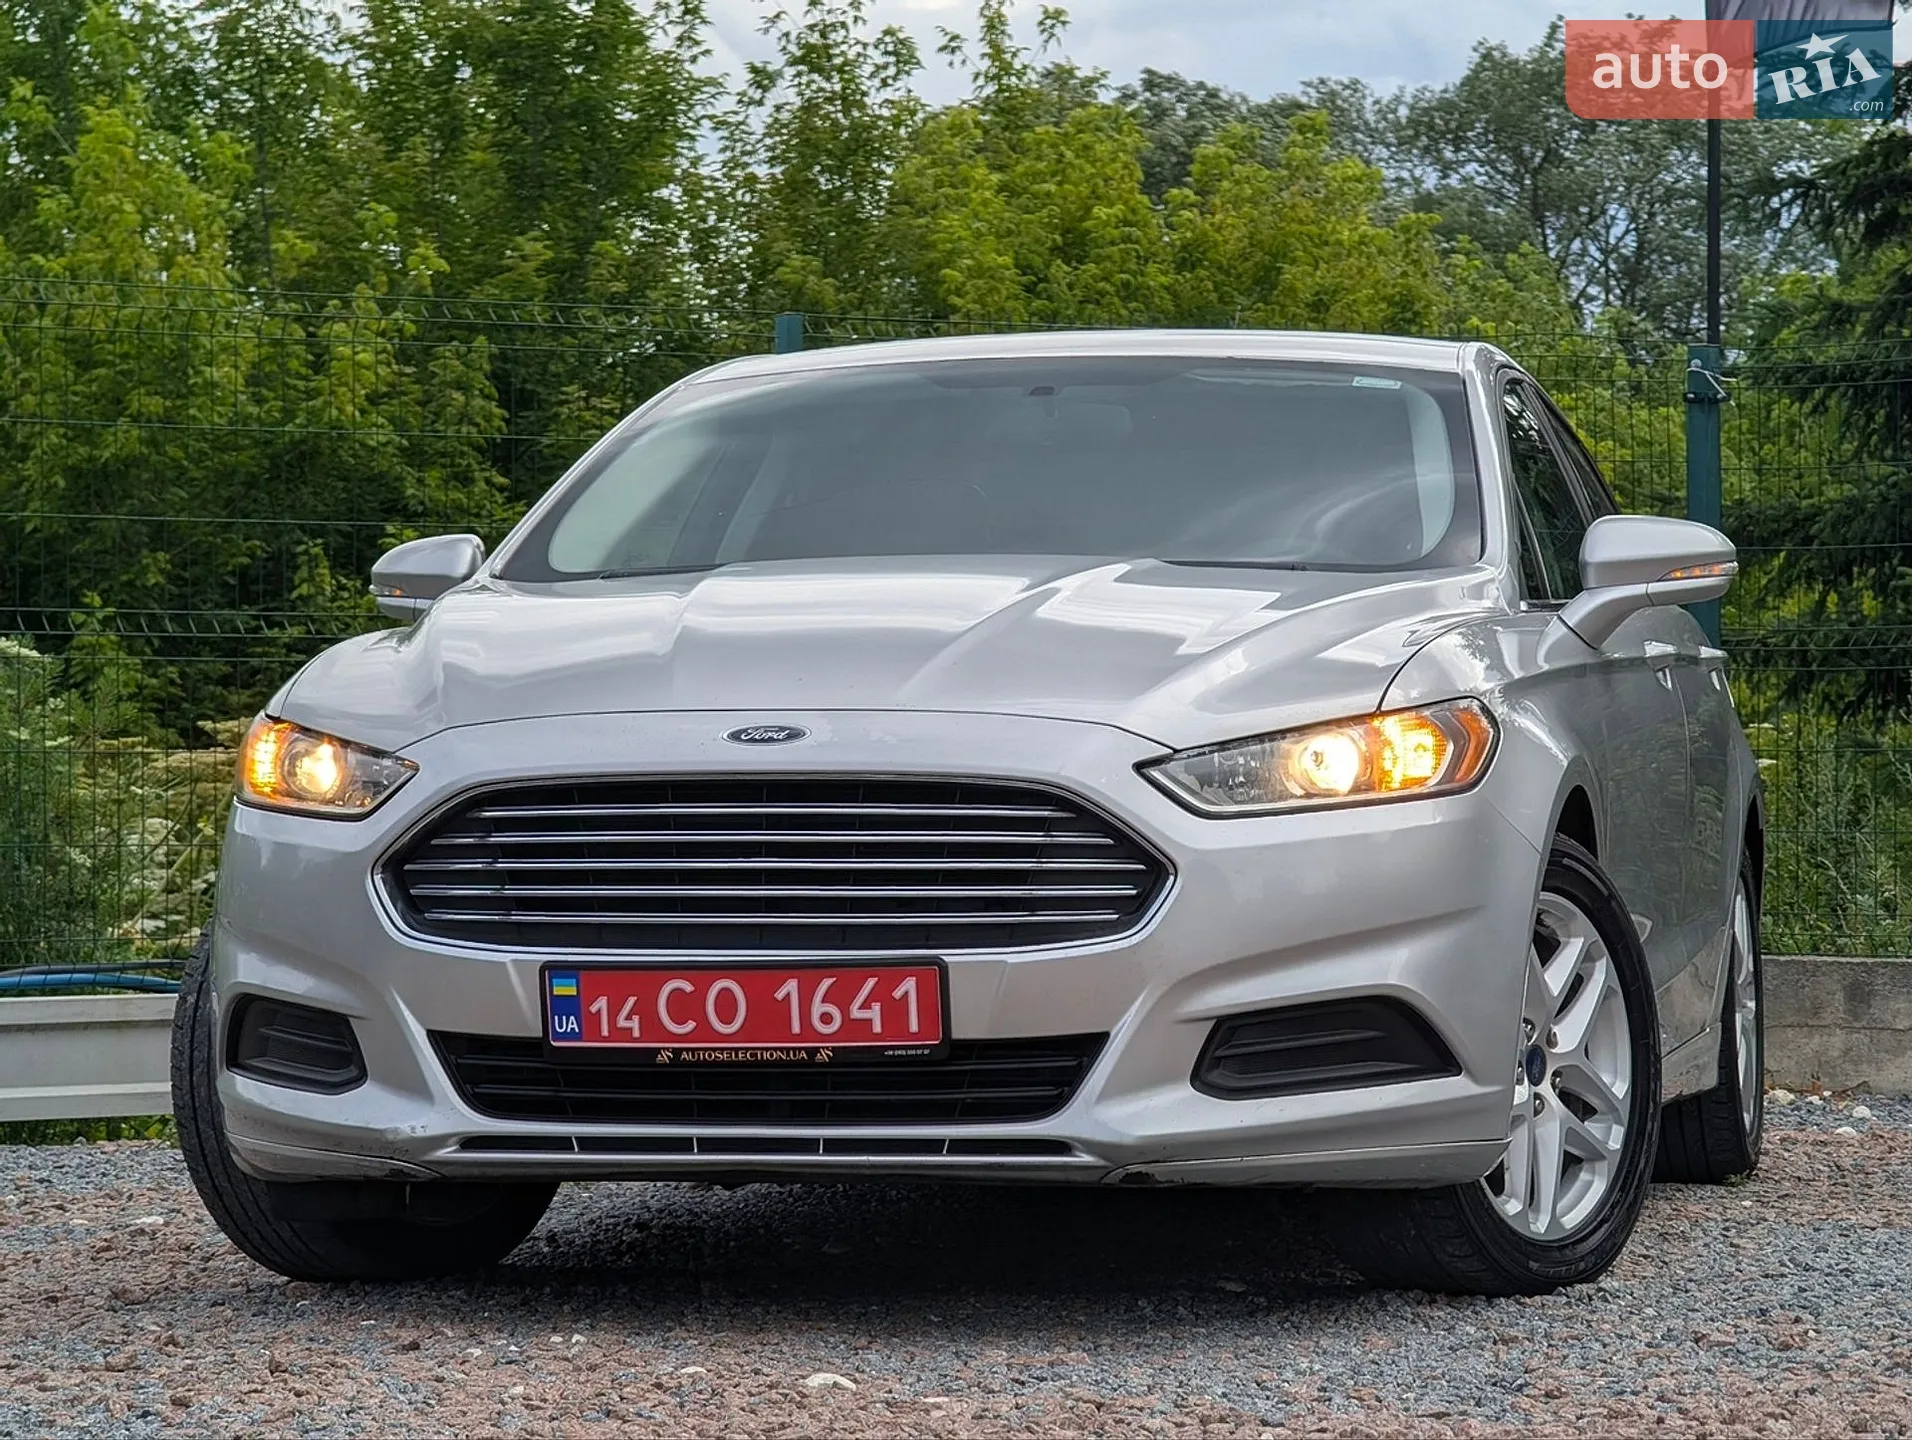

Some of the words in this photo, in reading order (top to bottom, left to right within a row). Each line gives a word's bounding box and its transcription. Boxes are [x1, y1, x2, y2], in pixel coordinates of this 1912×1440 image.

[741, 728, 790, 739] Ford
[589, 996, 641, 1038] 14
[656, 978, 748, 1035] CO
[773, 976, 920, 1034] 1641
[555, 1014, 580, 1033] UA
[679, 1050, 808, 1062] AUTOSELECTION.UA
